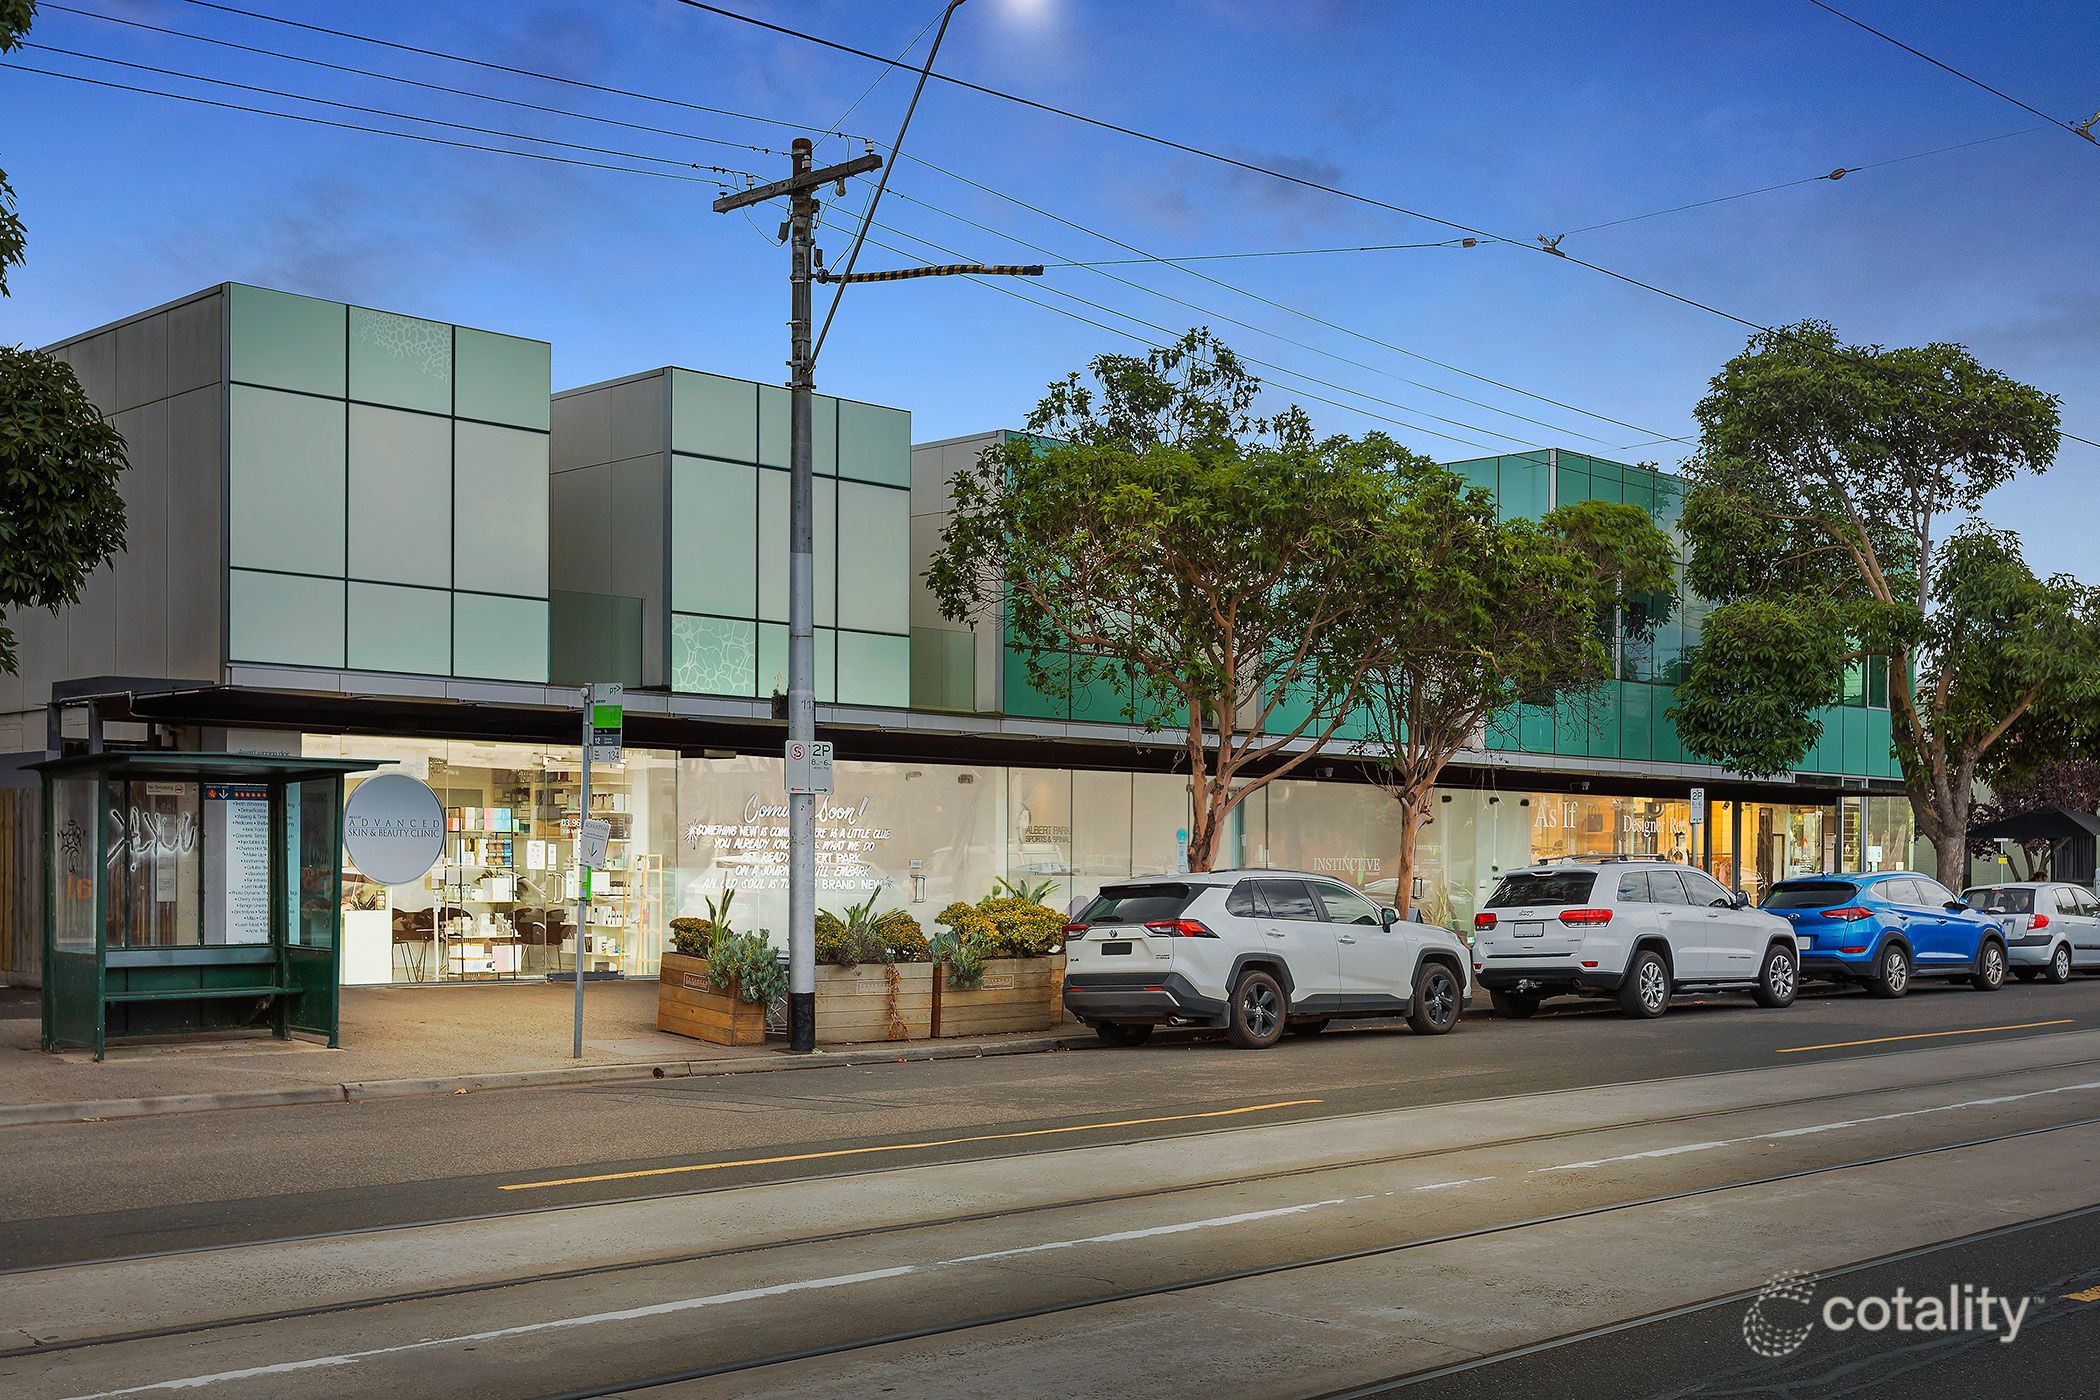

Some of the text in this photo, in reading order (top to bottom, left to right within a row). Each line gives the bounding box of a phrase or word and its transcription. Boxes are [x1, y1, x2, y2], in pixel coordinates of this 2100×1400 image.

[812, 745, 830, 756] 2P
[1692, 792, 1702, 800] 2P
[815, 795, 870, 825] Soon!
[1534, 799, 1578, 829] As If
[349, 819, 440, 828] ADVANCED
[1623, 815, 1665, 837] Designer
[348, 828, 440, 838] SKIN & BEAUTY CLINIC
[1026, 825, 1071, 835] ALBERT PARK
[1026, 835, 1047, 843] SPORTS
[714, 838, 732, 849] YOU
[733, 838, 770, 850] ALREADY
[863, 842, 876, 852] DO
[1313, 857, 1380, 871] INSTINCTIVE
[821, 880, 856, 890] BRAND
